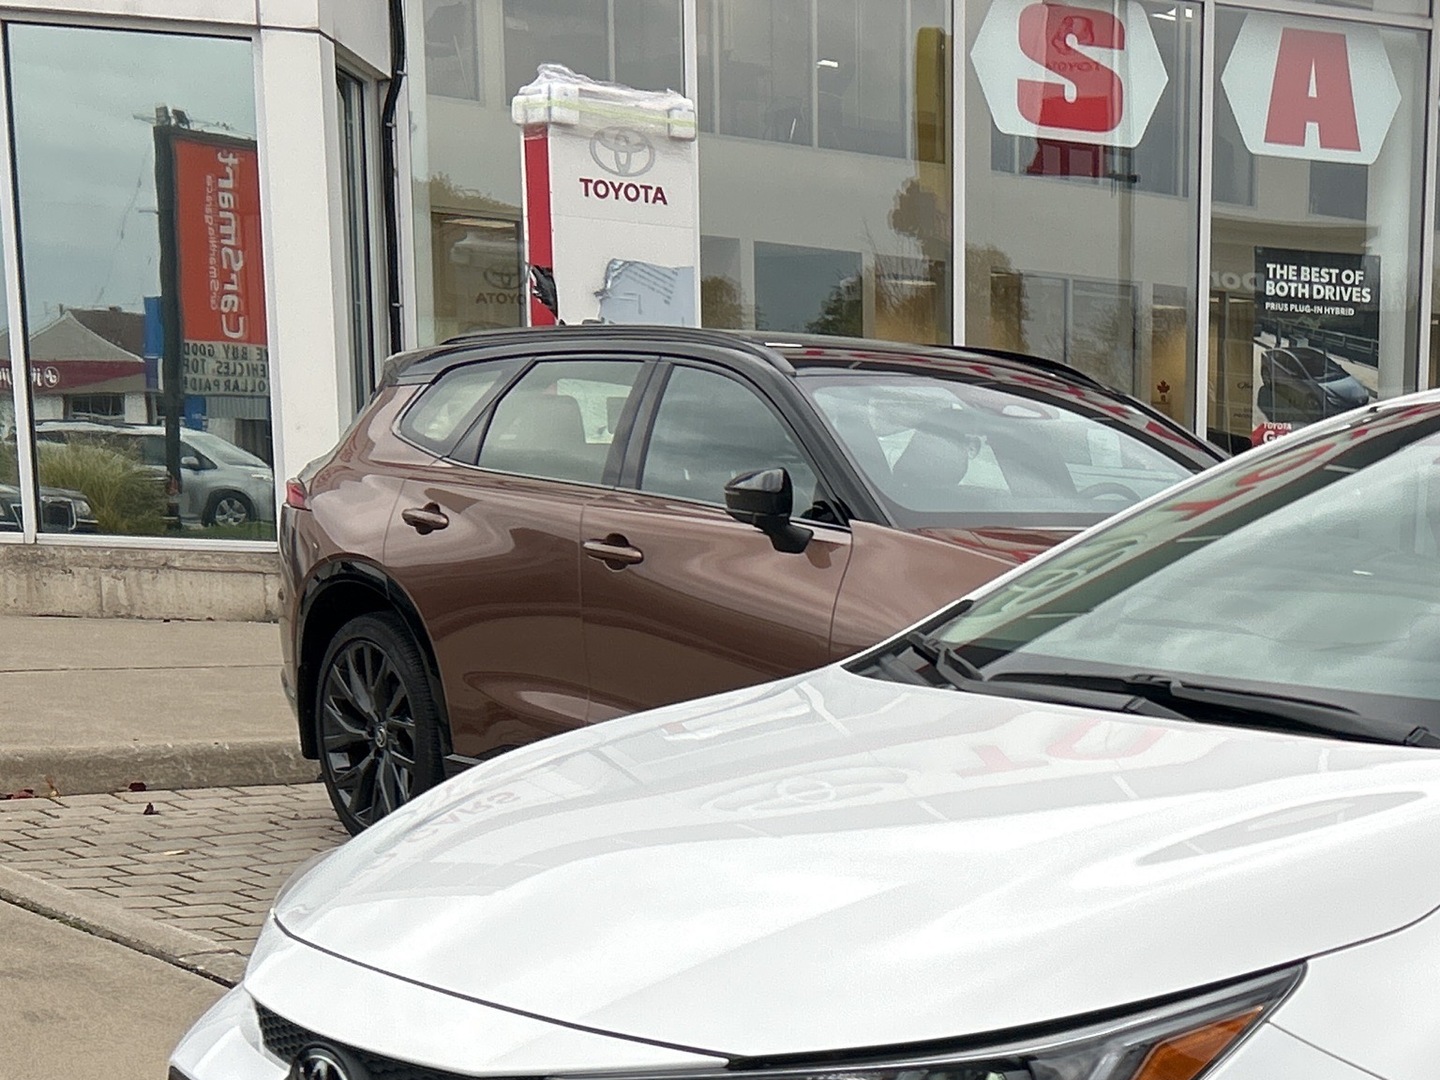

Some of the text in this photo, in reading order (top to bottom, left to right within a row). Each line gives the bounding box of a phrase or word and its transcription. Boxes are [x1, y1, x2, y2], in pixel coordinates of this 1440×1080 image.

[579, 177, 668, 206] TOYOTA
[1266, 263, 1298, 281] THE
[1300, 266, 1339, 284] BEST
[1341, 269, 1364, 285] OF
[1265, 280, 1309, 299] BOTH
[1313, 283, 1371, 303] DRIVES
[1265, 302, 1355, 316] PRIUS PLUG-IN HYBRID
[1263, 422, 1292, 430] TOYOTA
